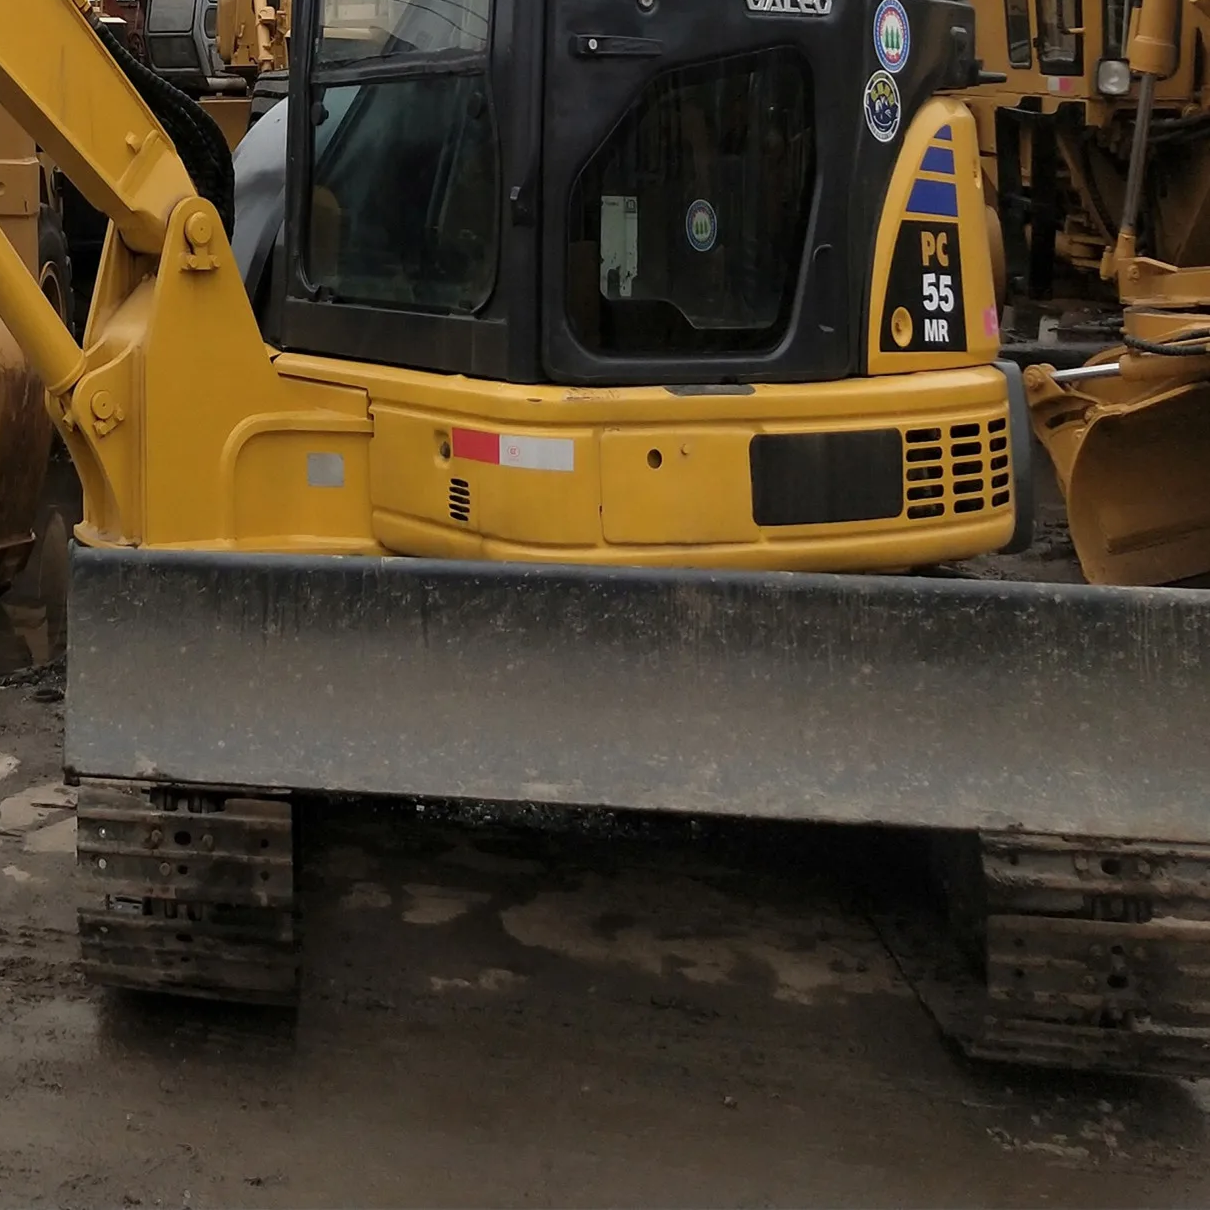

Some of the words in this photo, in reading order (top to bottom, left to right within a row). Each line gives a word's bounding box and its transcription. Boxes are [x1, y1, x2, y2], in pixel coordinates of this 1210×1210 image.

[921, 231, 949, 267] PC
[922, 273, 954, 312] 55
[924, 318, 949, 342] MR
